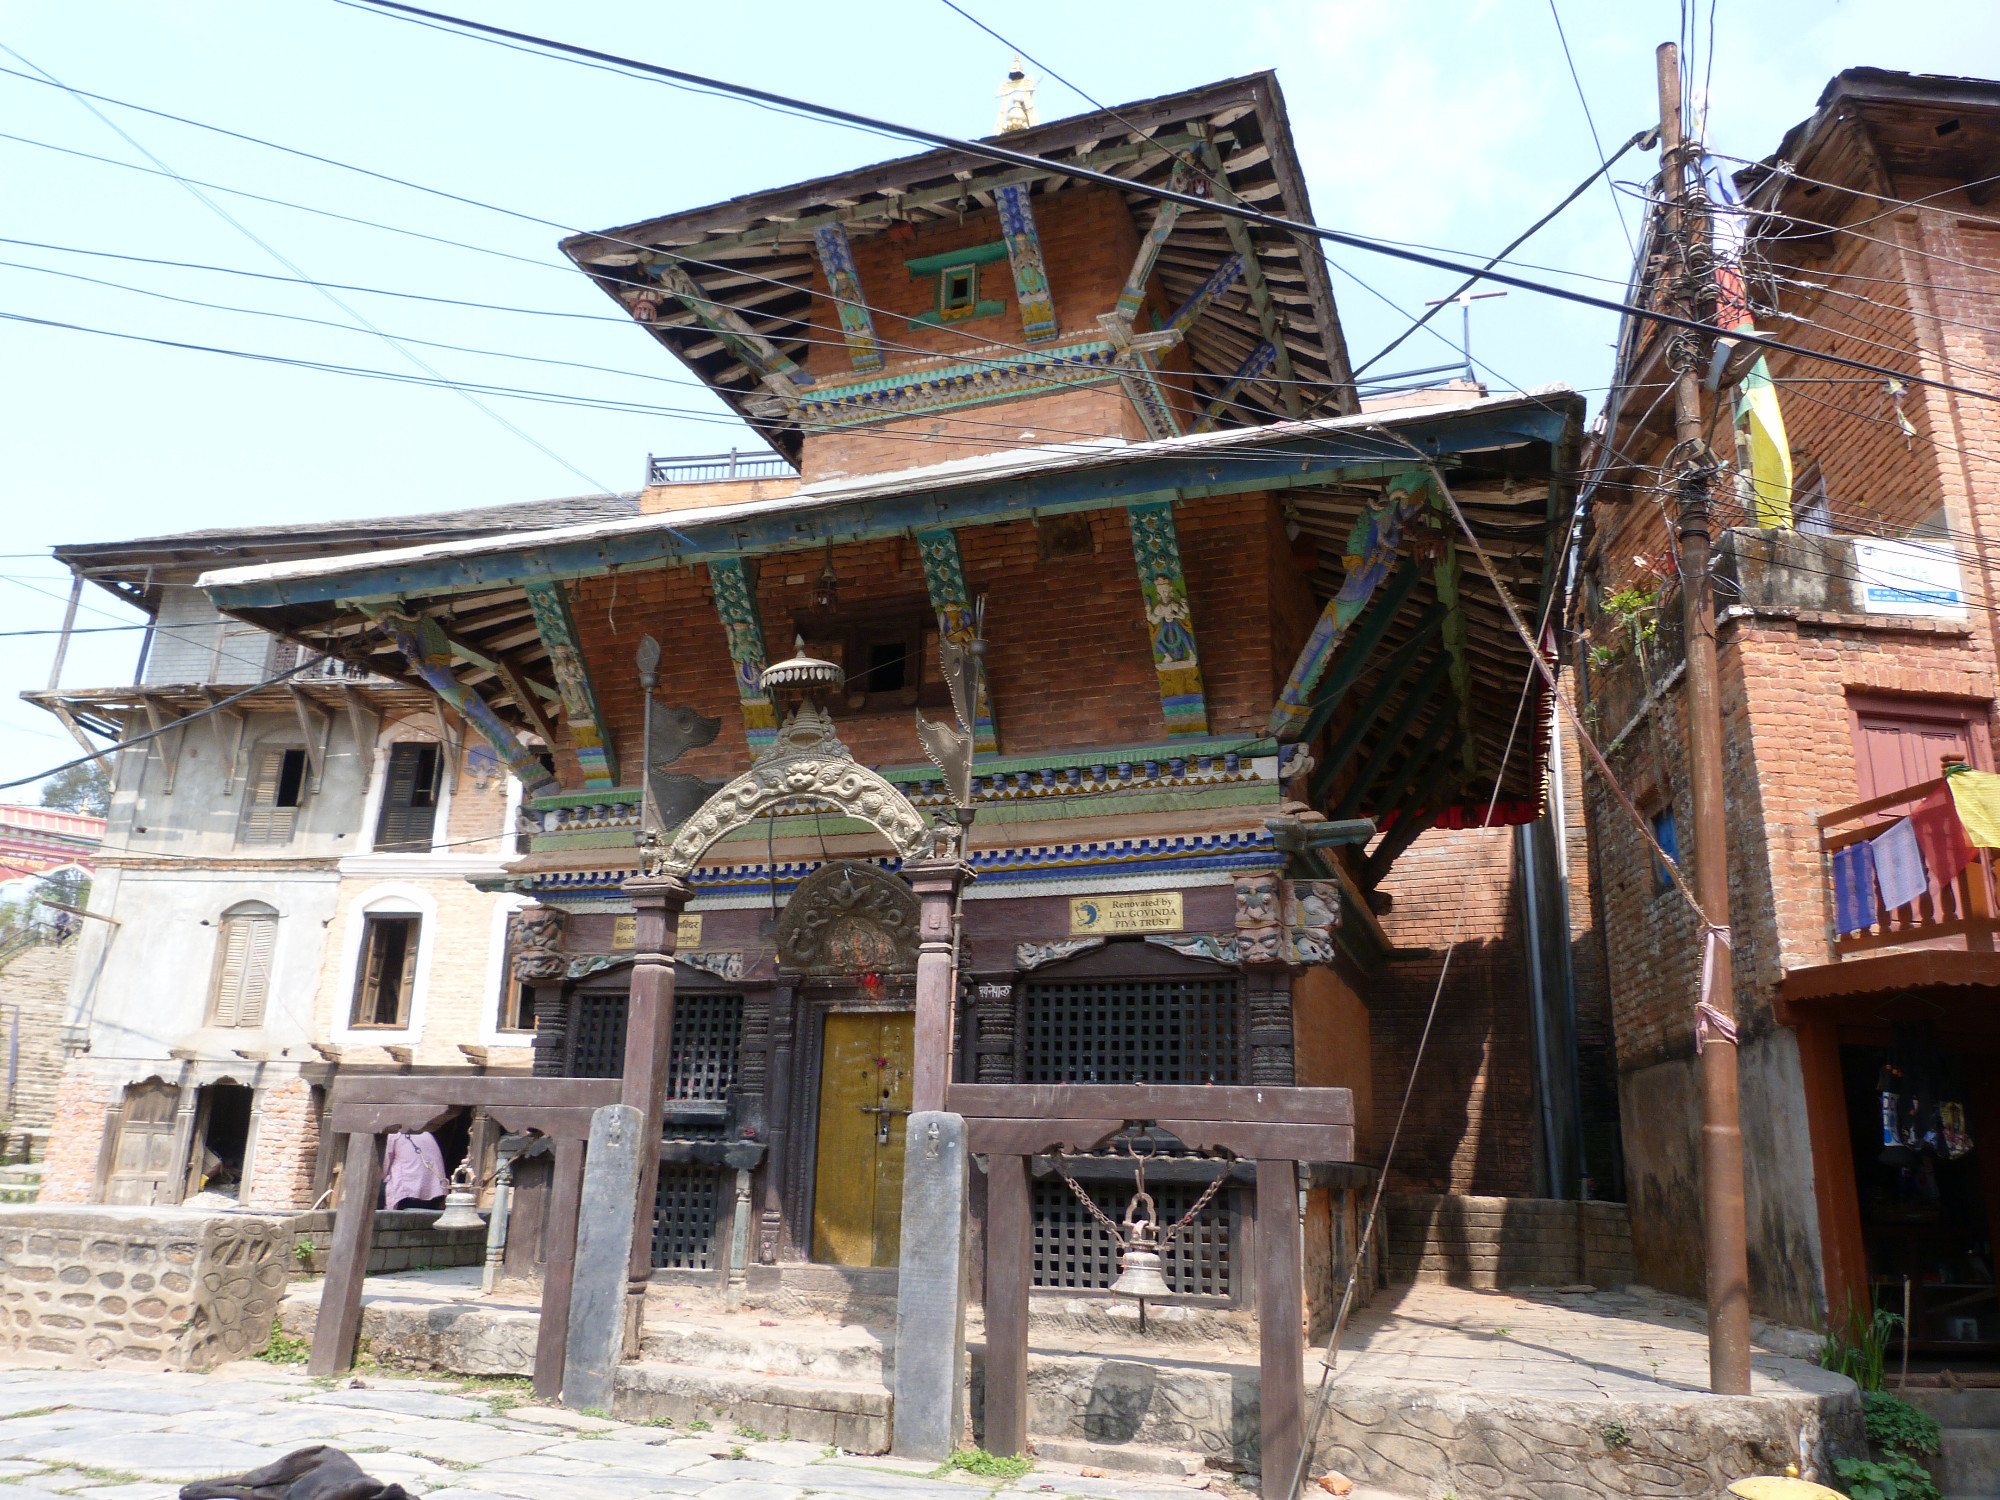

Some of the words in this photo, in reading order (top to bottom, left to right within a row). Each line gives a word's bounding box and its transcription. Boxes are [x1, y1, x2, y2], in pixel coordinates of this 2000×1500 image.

[1112, 898, 1159, 909] Renovated
[1162, 898, 1173, 908] by
[1109, 911, 1127, 919] LAL
[1129, 908, 1177, 918] GOVINDA
[1115, 920, 1137, 928] PIYA
[1139, 918, 1171, 927] TRUST
[615, 935, 636, 944] Bindh
